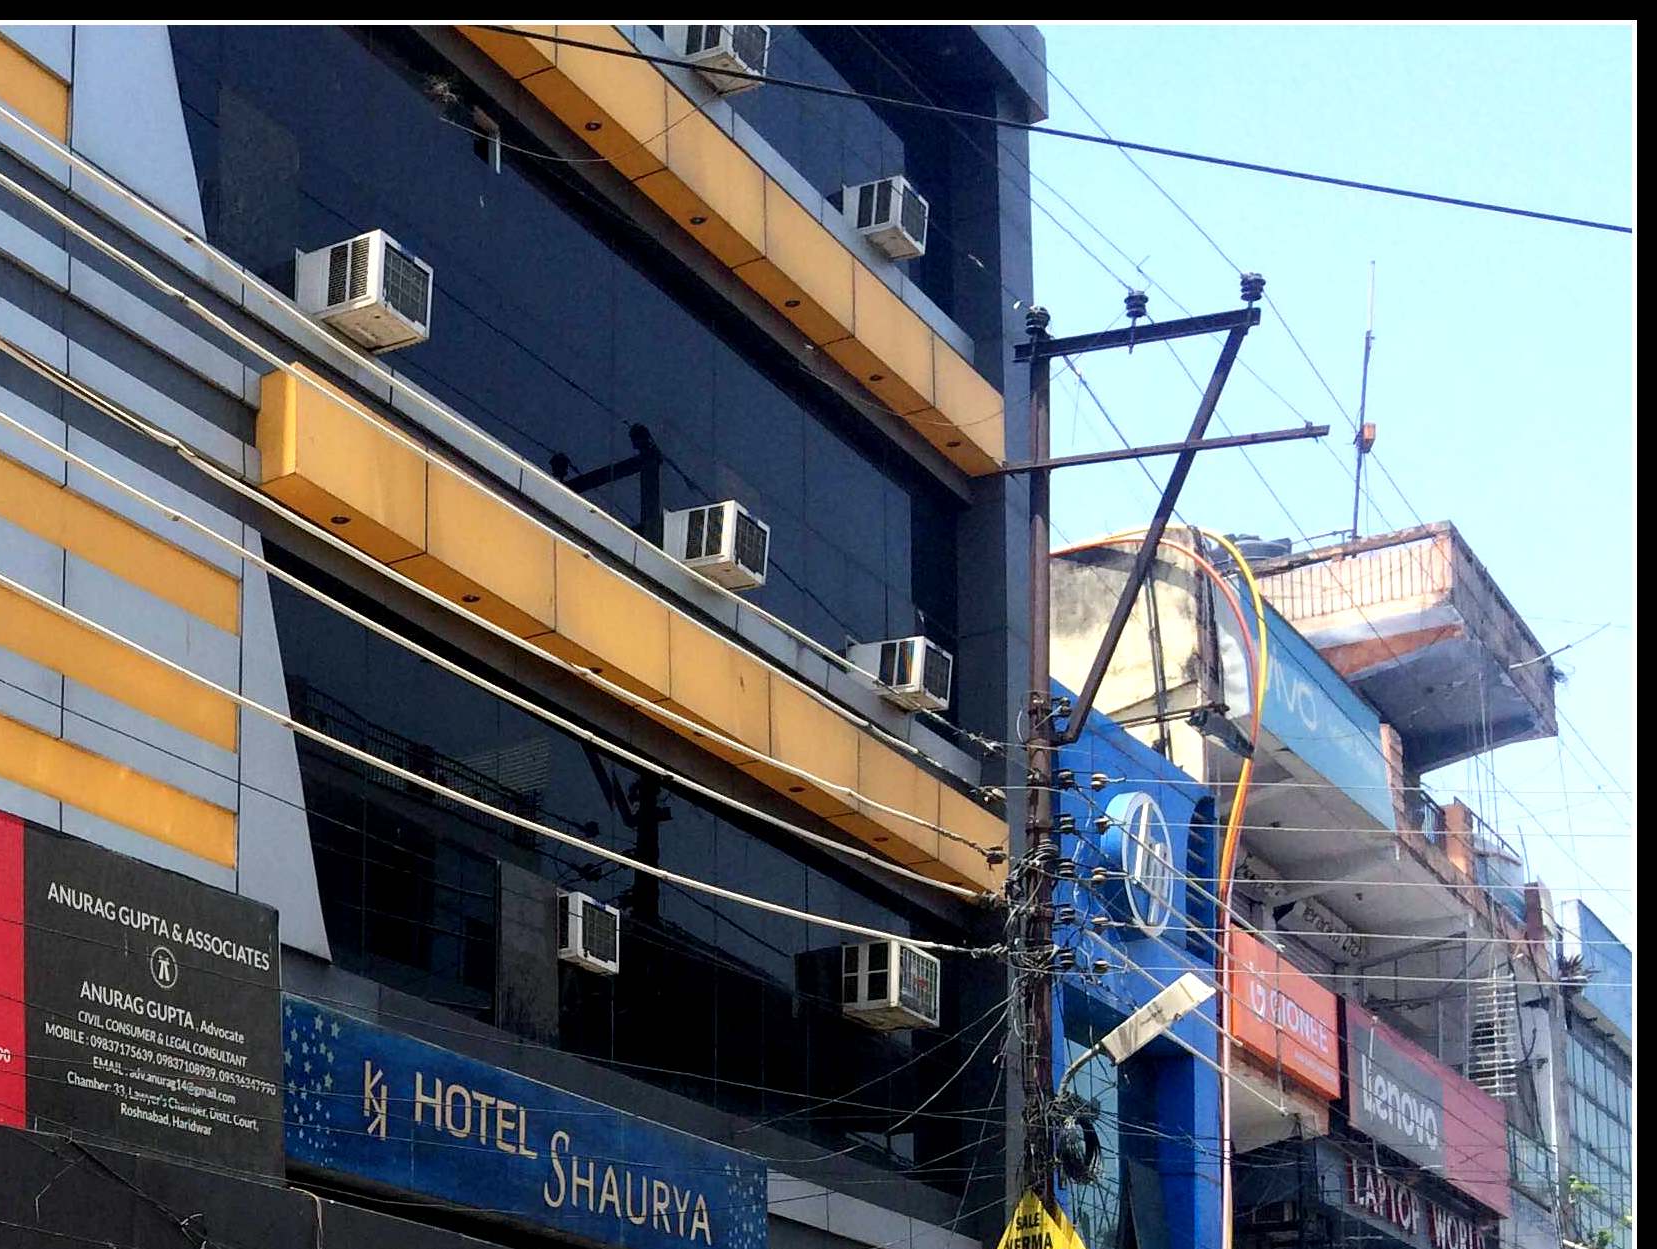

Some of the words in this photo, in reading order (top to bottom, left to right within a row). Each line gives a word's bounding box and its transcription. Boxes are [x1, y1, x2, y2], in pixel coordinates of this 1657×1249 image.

[48, 882, 115, 921] ANURAG
[119, 906, 169, 939] GUPTA
[172, 924, 182, 942] &
[185, 929, 270, 971] ASSOCIATES
[45, 1022, 85, 1044] MOBILE
[80, 981, 143, 1015] ANURAG
[200, 1020, 244, 1044] Advocate
[105, 1018, 156, 1042] CONSUMER
[157, 1032, 163, 1045] &
[165, 1035, 191, 1053] LEGAL
[193, 1043, 247, 1068] CONSULTANT
[121, 1103, 171, 1128] Roshnabad,
[173, 1115, 212, 1136] Haridwar
[414, 1071, 537, 1160] HOTEL
[543, 1129, 712, 1247] SHAURYA
[1016, 1212, 1040, 1231] SALE
[1347, 1156, 1420, 1235] LAPTOP
